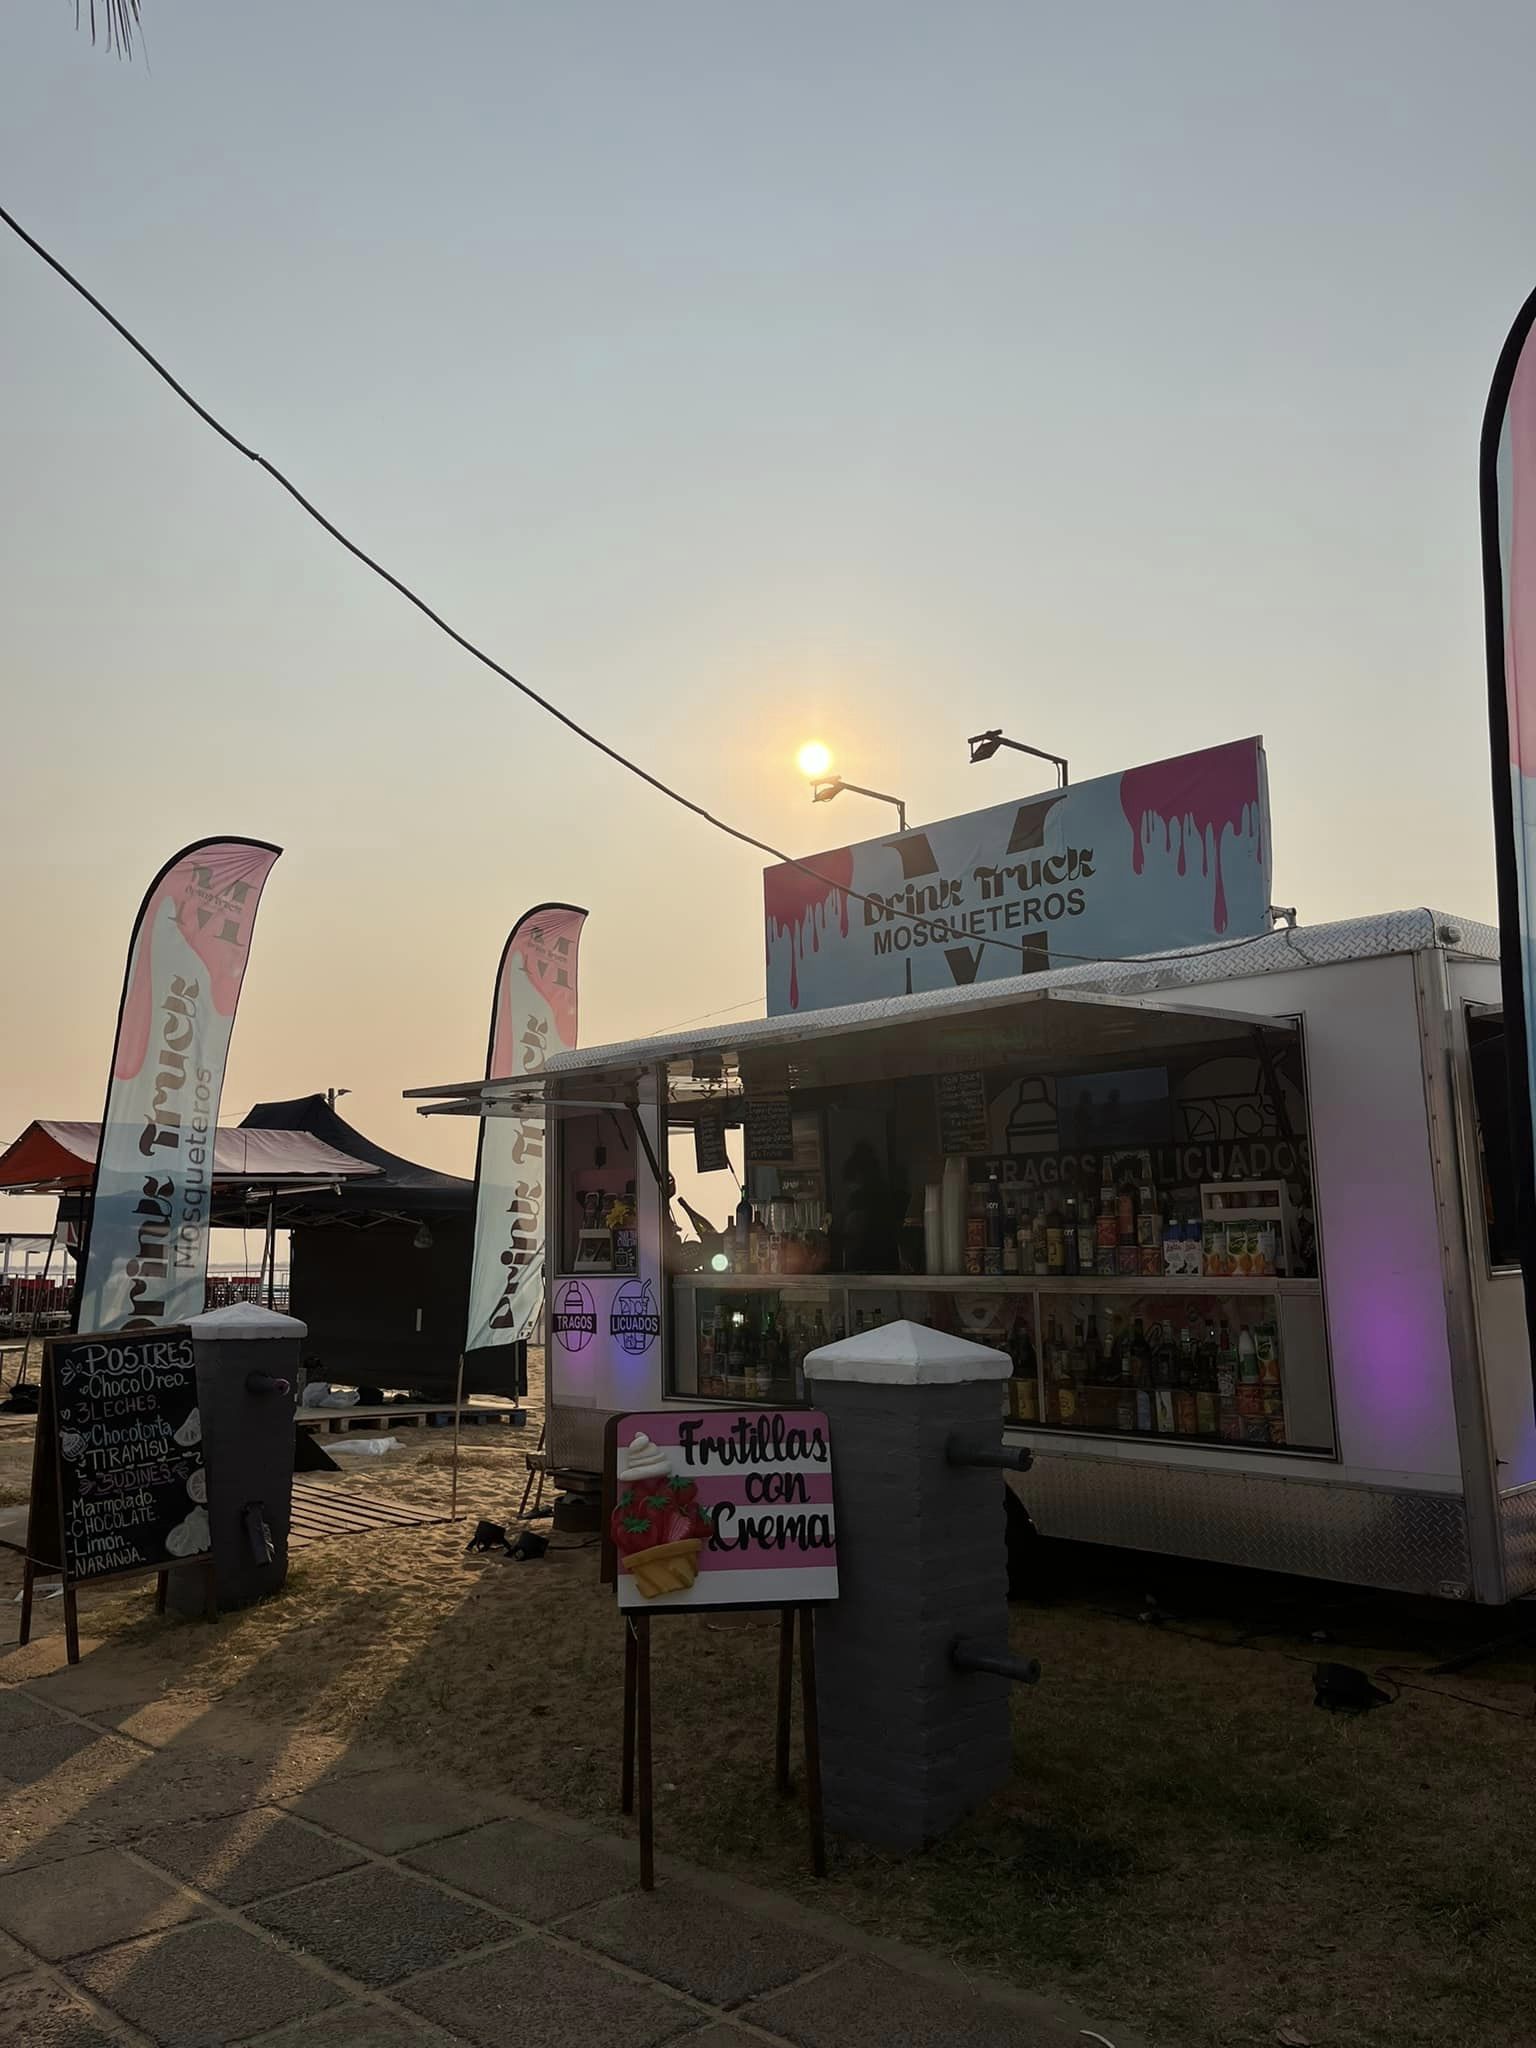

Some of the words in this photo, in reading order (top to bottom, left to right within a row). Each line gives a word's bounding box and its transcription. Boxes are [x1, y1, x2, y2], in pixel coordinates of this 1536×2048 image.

[863, 877, 965, 927] Drink
[973, 846, 1097, 901] Truck
[873, 888, 1086, 956] MOSQUETEROS
[138, 974, 199, 1156] Truck
[173, 1066, 212, 1270] Mosqueteros
[556, 1315, 593, 1331] TRAGOS
[611, 1316, 659, 1332] LICUADOS
[72, 1340, 193, 1374] POSTRES
[678, 1413, 828, 1466] Frutillas
[744, 1471, 811, 1504] con
[707, 1501, 838, 1552] Crema
